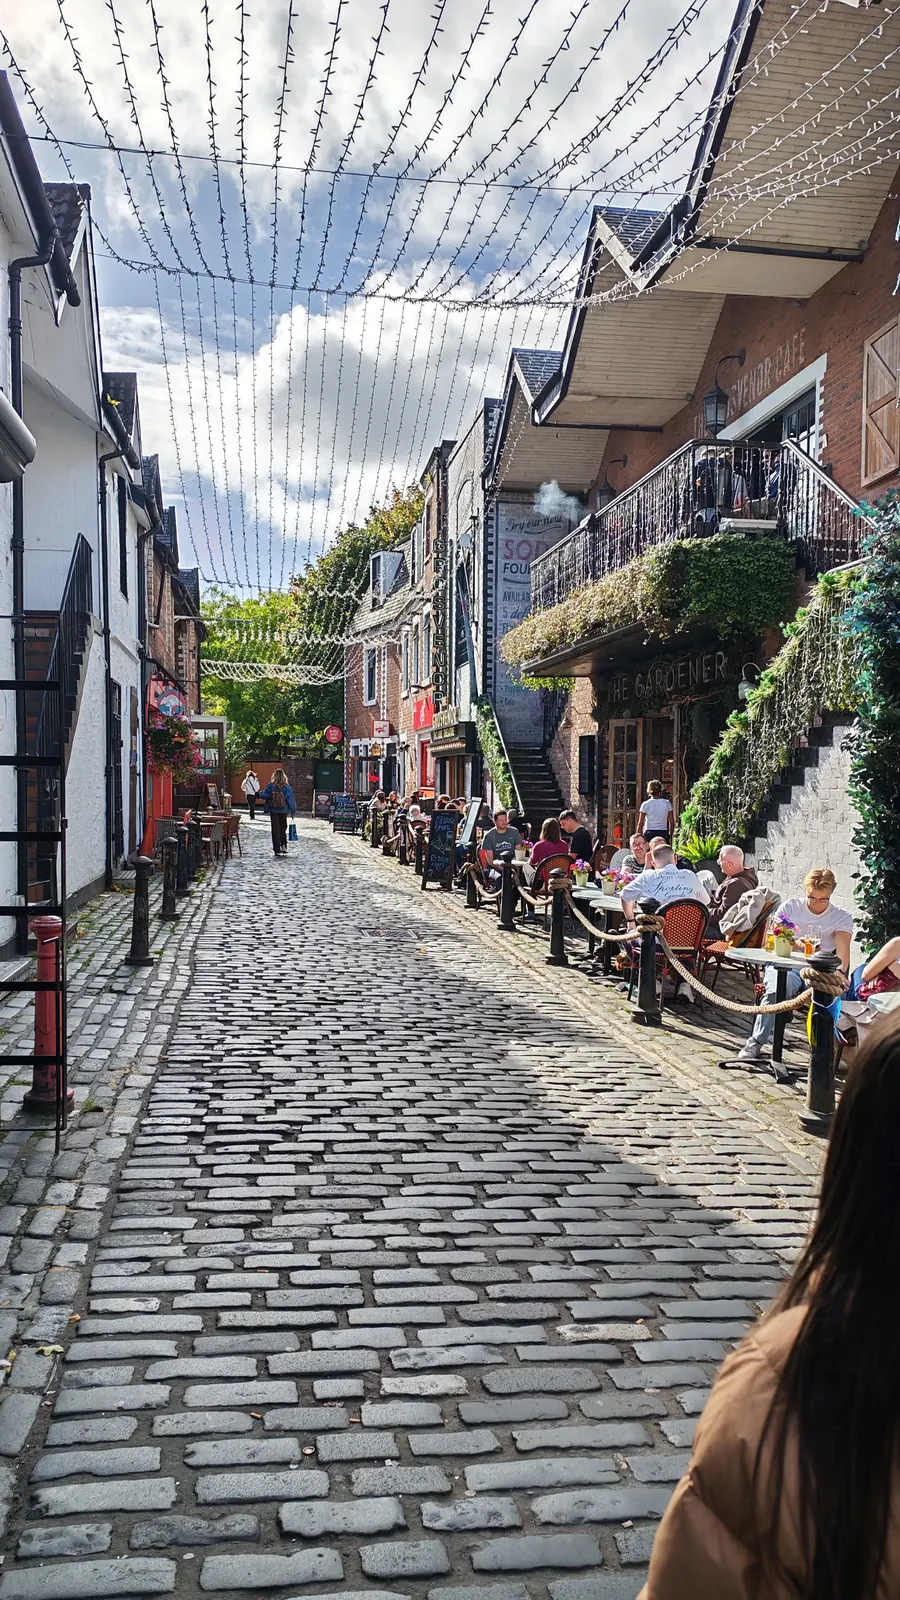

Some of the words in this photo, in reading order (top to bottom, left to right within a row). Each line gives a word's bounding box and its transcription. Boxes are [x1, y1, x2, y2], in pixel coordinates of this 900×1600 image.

[775, 324, 806, 382] CAFE
[505, 518, 525, 534] Try
[503, 538, 549, 561] SOD
[503, 562, 530, 575] FOU
[607, 677, 628, 702] THE
[634, 651, 728, 698] GARDENER
[648, 880, 694, 896] Sporting
